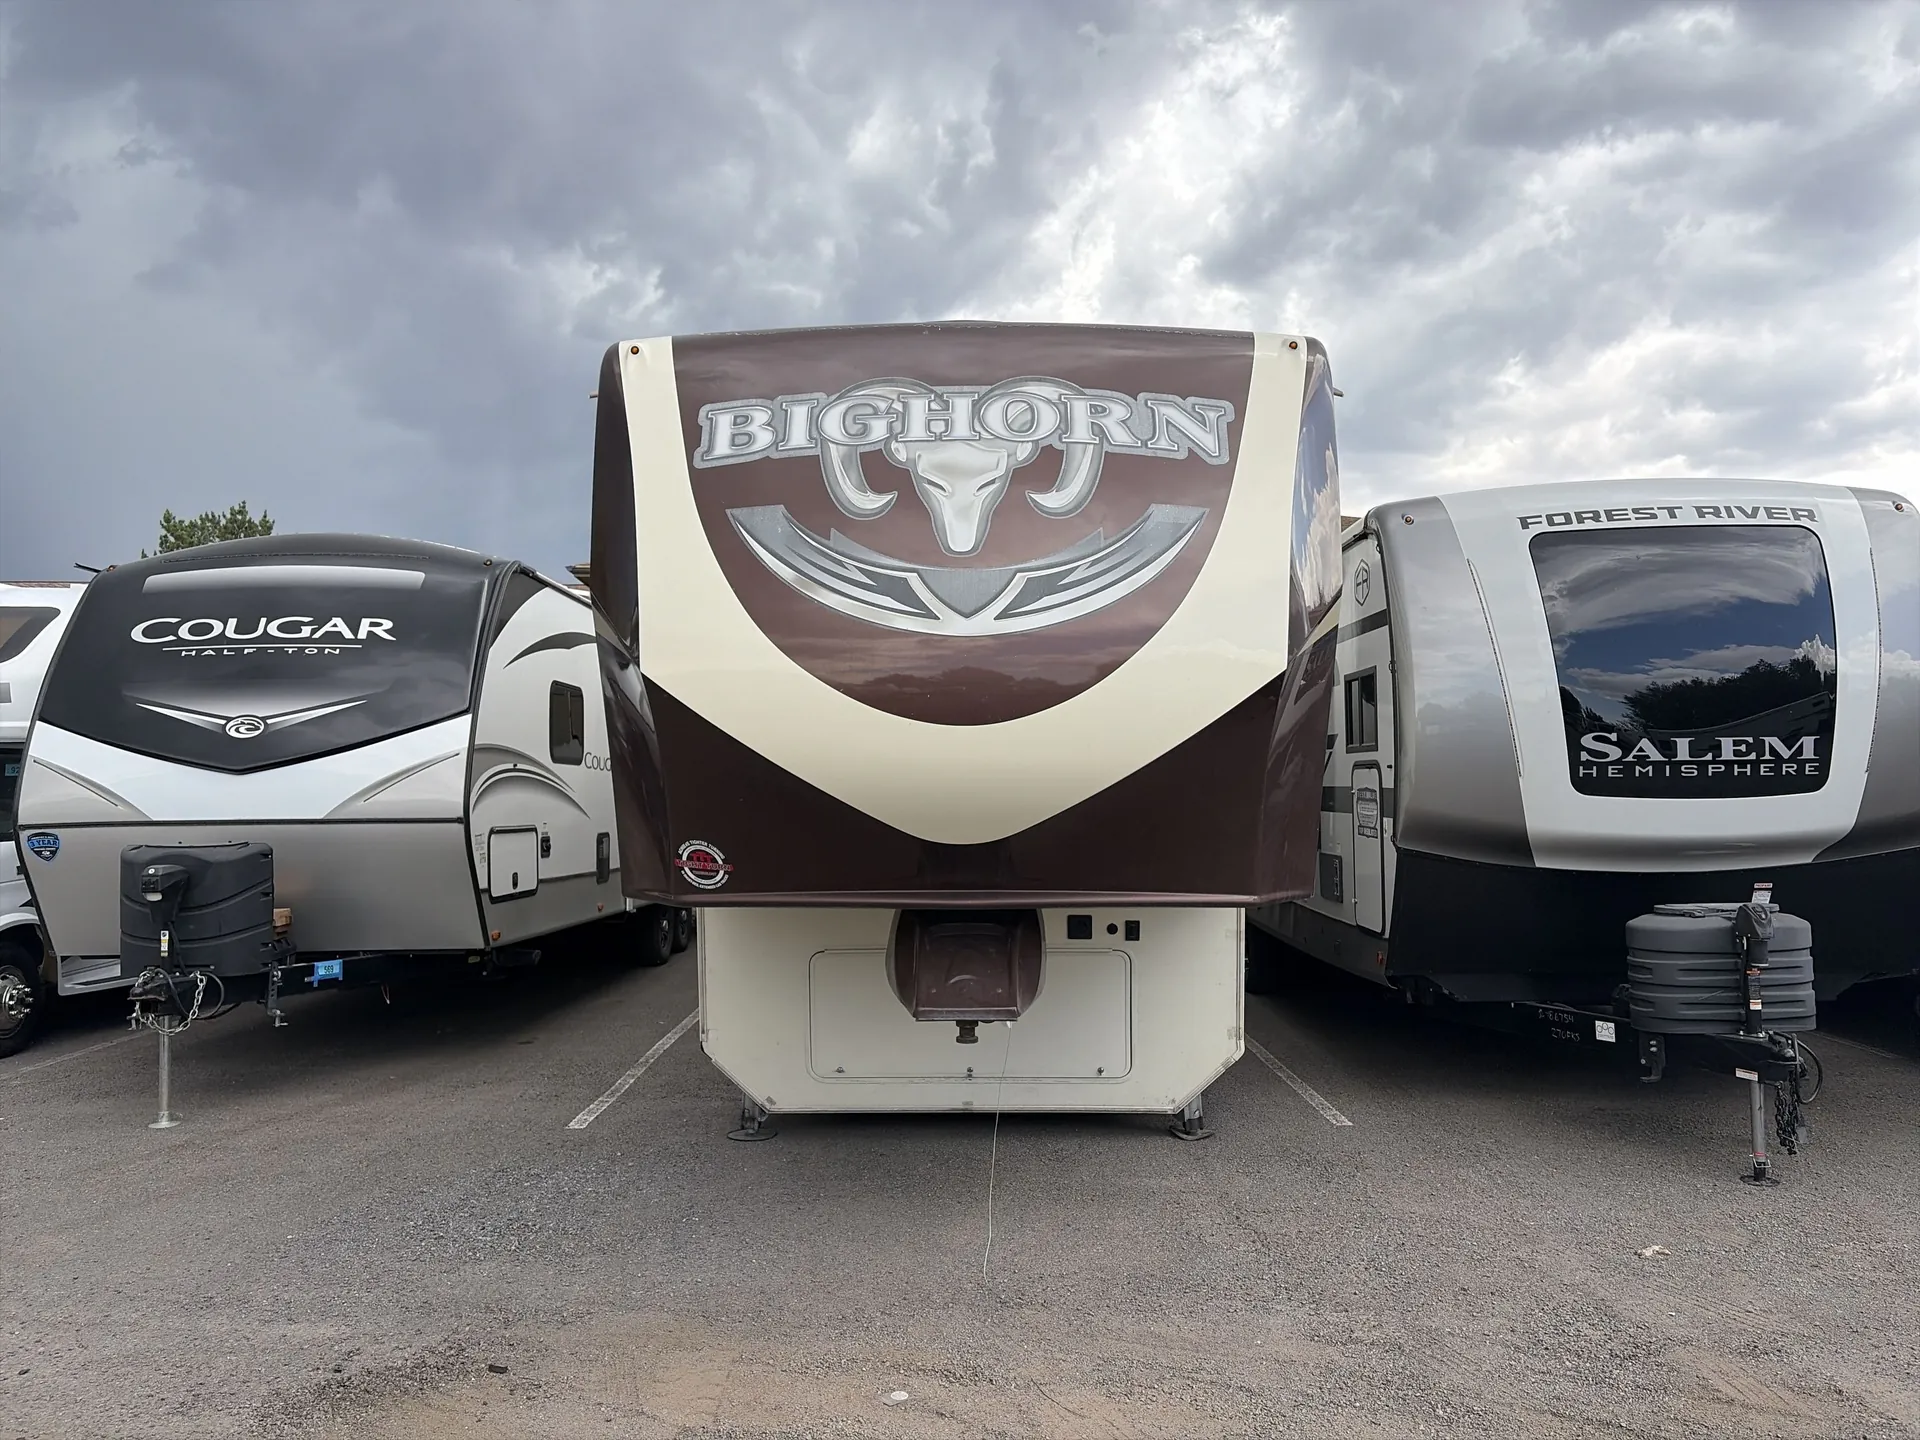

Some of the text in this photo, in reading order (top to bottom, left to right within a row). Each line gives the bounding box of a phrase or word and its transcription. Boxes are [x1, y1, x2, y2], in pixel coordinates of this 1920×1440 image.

[703, 391, 1228, 463] BIGHORN
[1516, 505, 1820, 530] FOREST RIVER
[130, 616, 397, 644] COUGAR
[1580, 732, 1821, 763] SALEM
[1579, 763, 1820, 778] HEMISPHERE
[36, 839, 58, 847] YEAR
